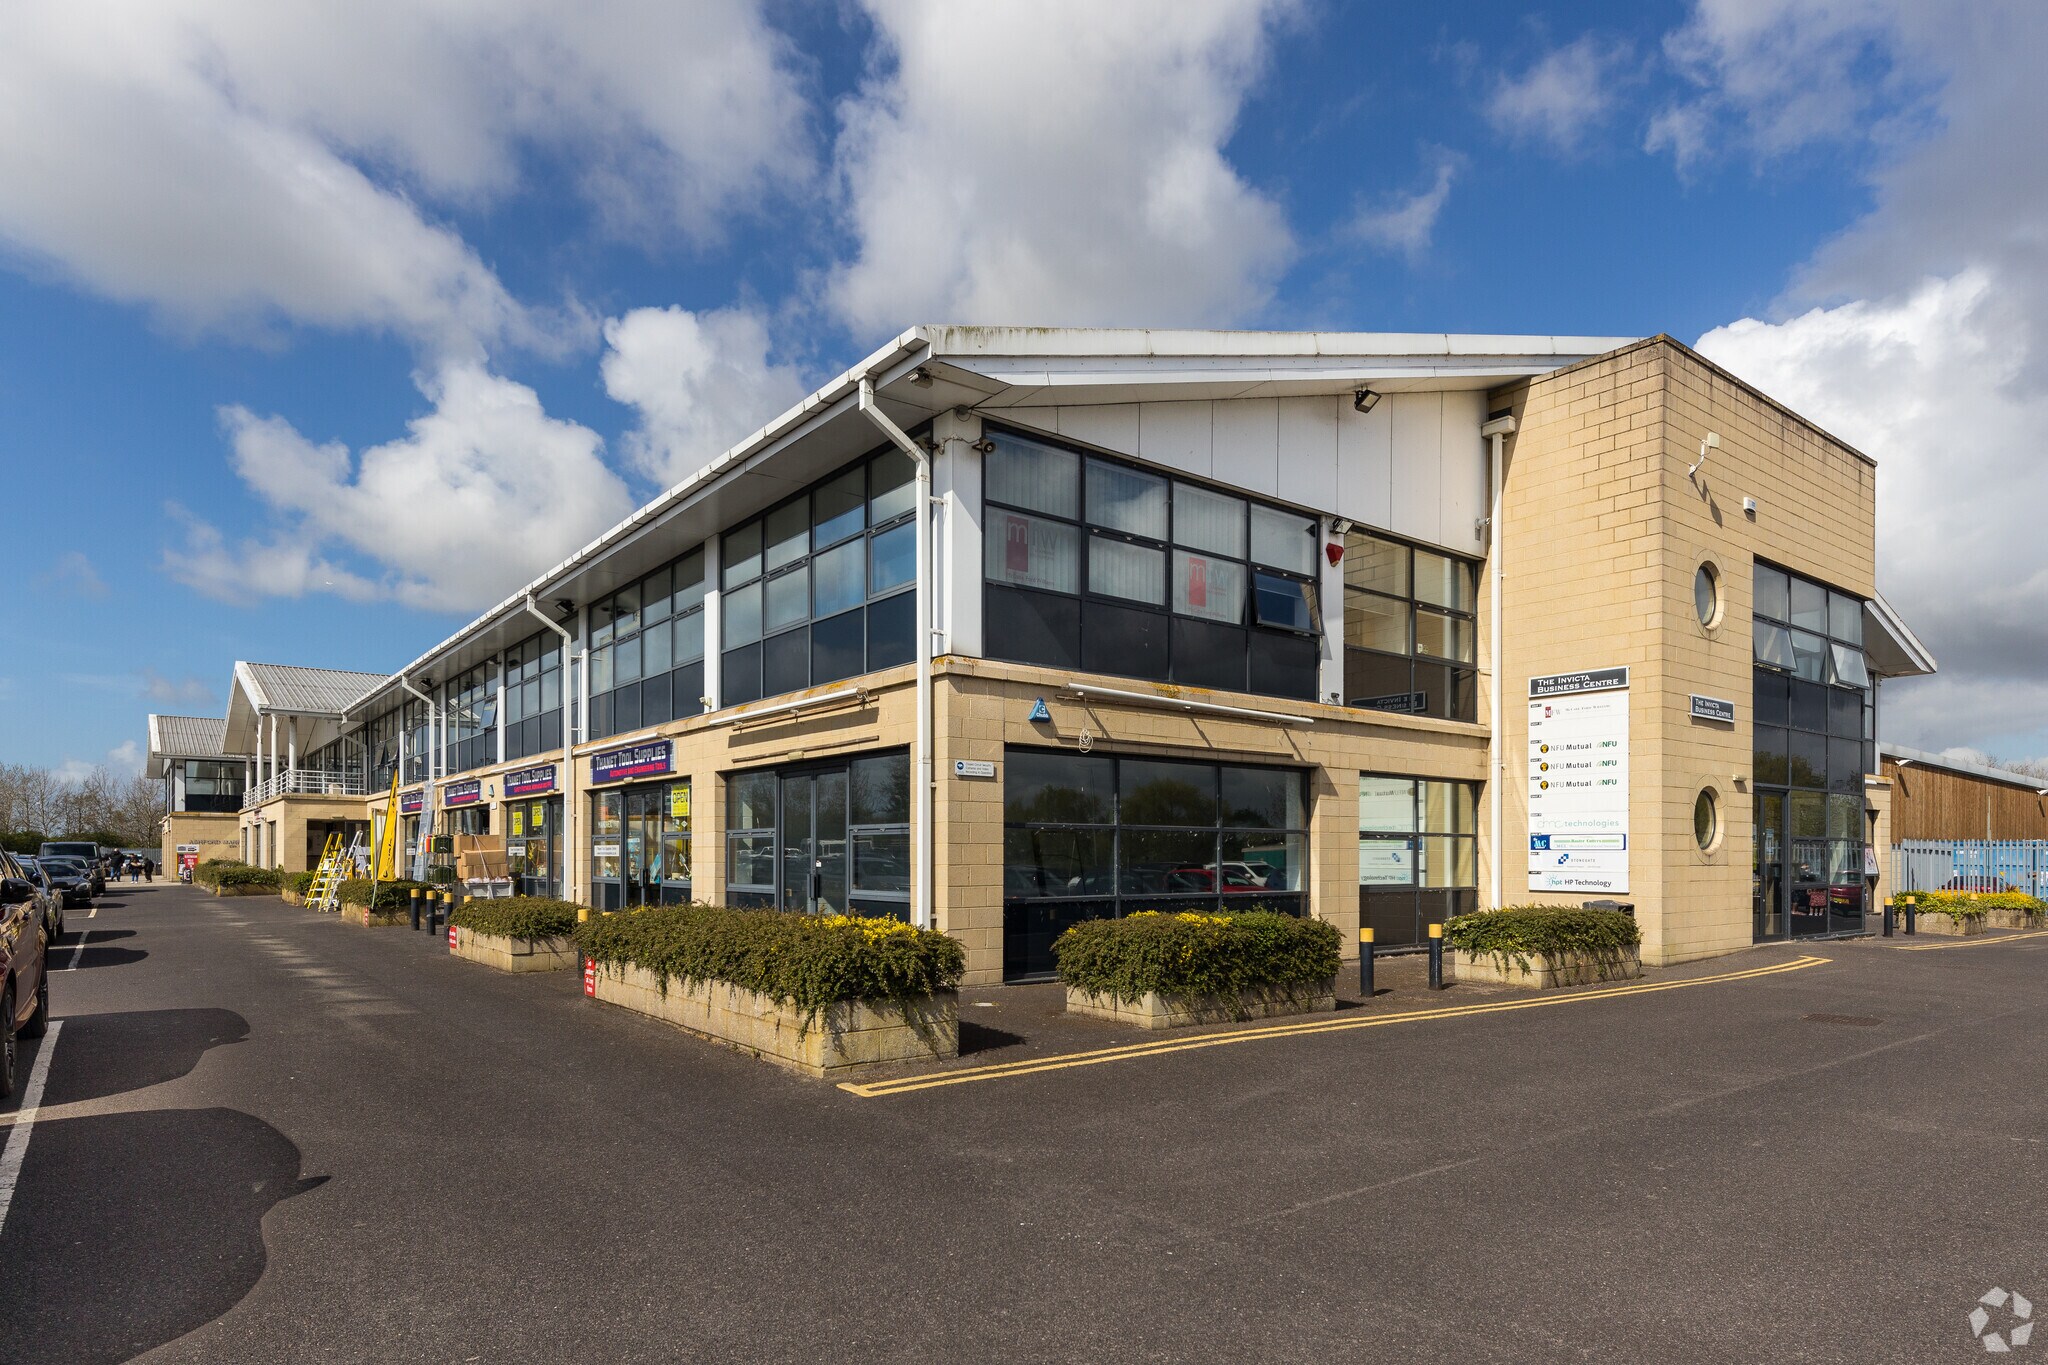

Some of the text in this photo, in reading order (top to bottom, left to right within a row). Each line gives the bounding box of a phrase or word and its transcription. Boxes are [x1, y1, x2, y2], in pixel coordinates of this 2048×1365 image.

[1537, 674, 1590, 687] THE INVICTA
[1537, 678, 1619, 693] BUSINESS CENTRE
[1695, 698, 1720, 709] THE INVICTA
[1695, 705, 1731, 718] BUSINESS CENTRE
[595, 745, 666, 771] THANET TOOL SUPPLIES
[1565, 761, 1592, 769] Mutual
[521, 772, 531, 784] TOOL
[532, 768, 552, 782] SUPPLIES
[673, 791, 688, 803] OPEN
[1564, 819, 1620, 828] technologies
[1575, 879, 1612, 888] Technology
